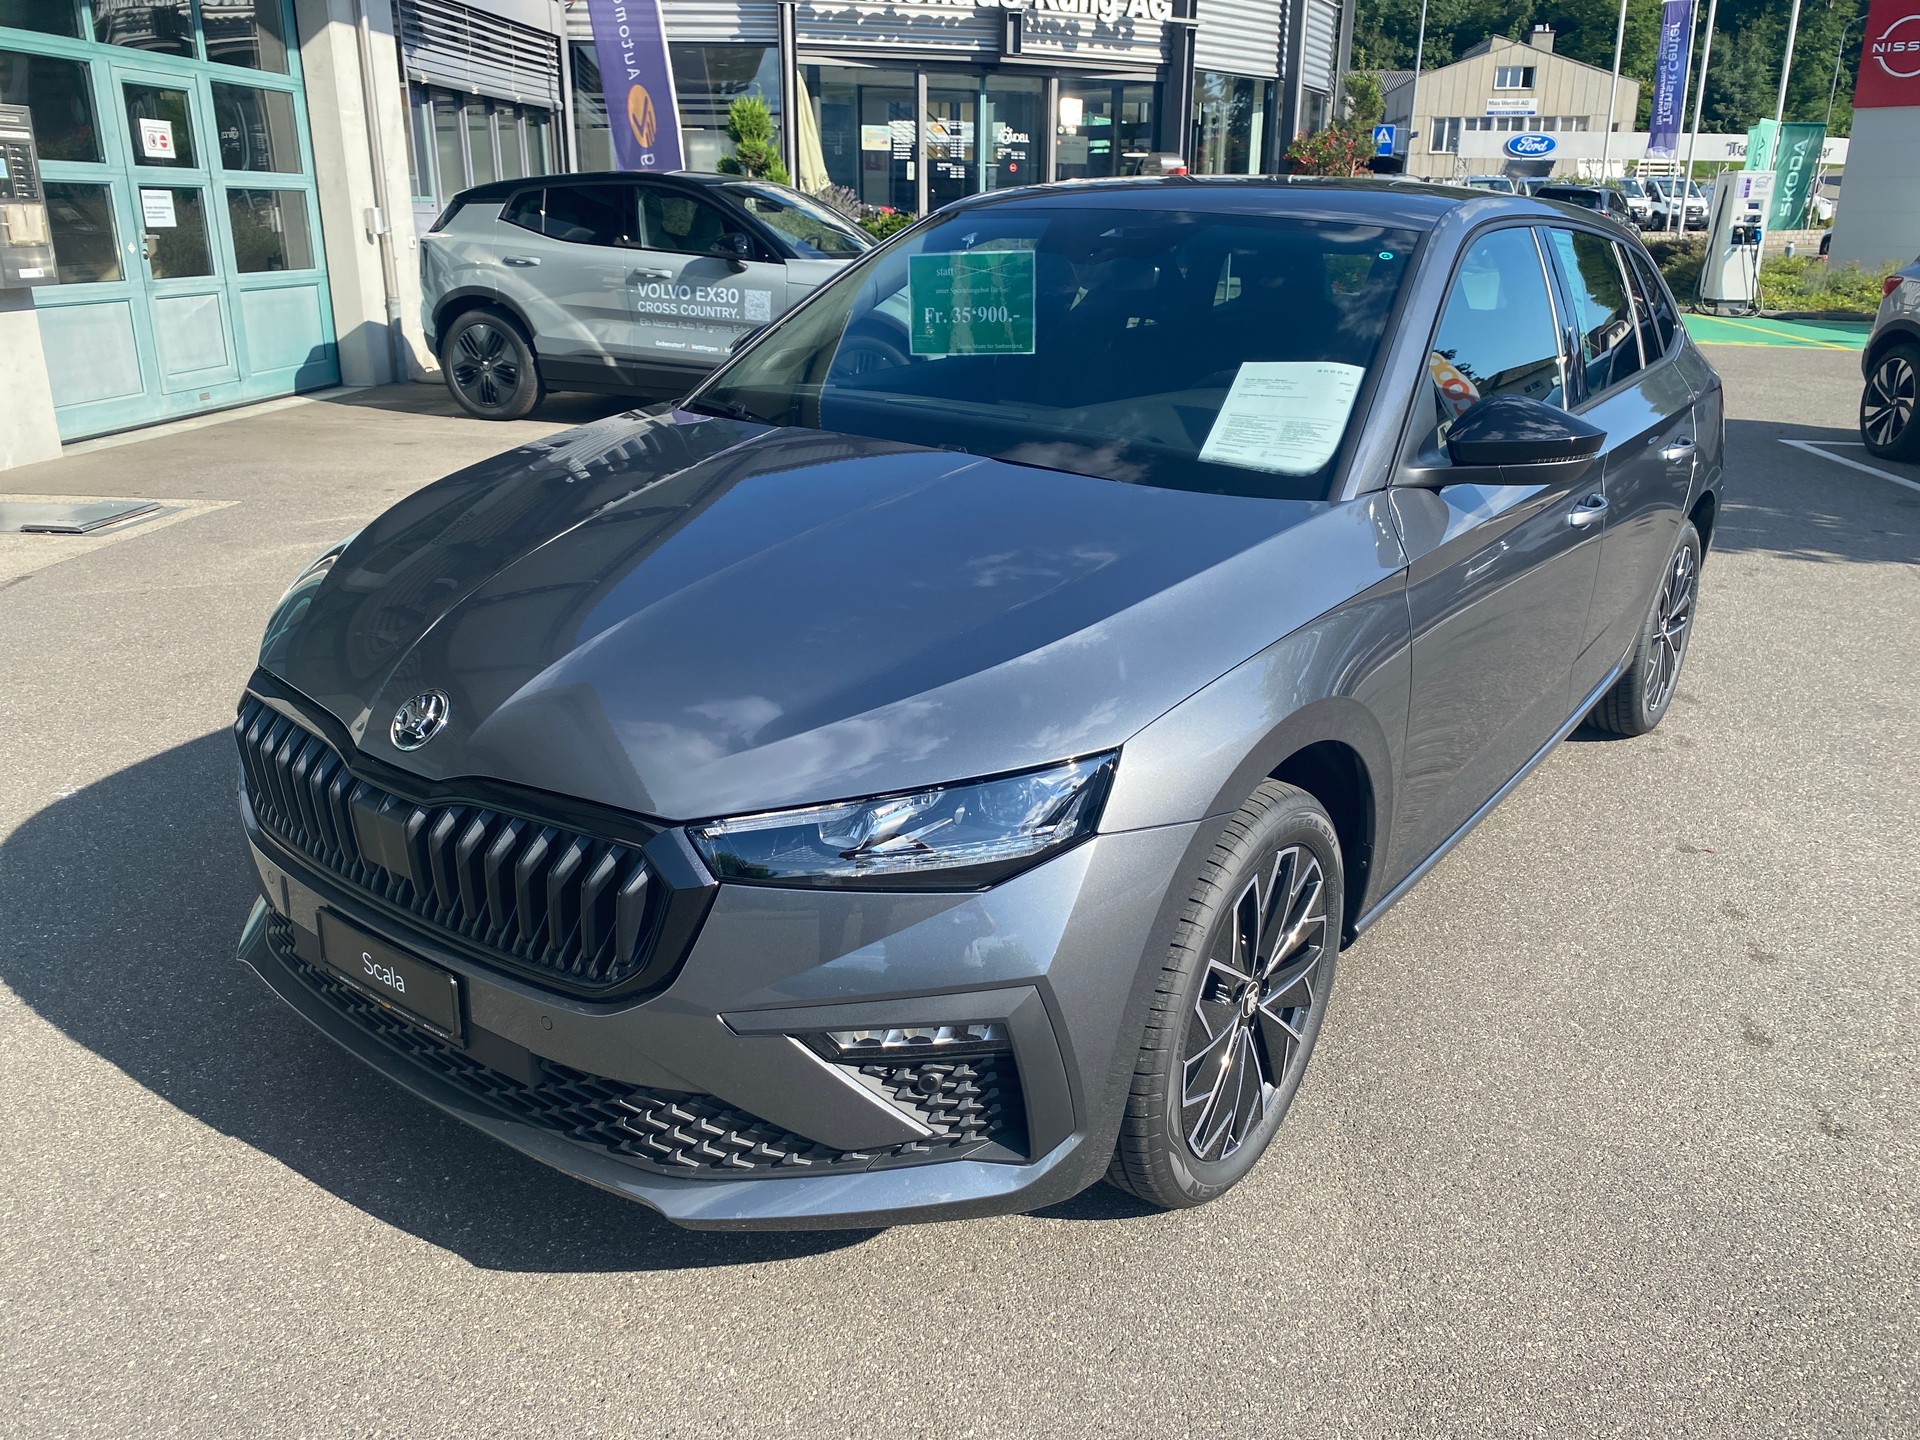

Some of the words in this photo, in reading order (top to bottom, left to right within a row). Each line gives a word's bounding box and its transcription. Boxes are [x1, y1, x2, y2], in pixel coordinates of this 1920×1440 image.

[1126, 0, 1174, 21] AG
[1517, 136, 1549, 152] Ford
[935, 267, 954, 276] statt
[637, 282, 691, 301] VOLVO
[695, 286, 740, 304] EX30
[637, 301, 678, 315] CROSS
[680, 304, 740, 320] COUNTRY.
[924, 307, 947, 324] Fr.
[640, 317, 651, 327] Ein
[653, 318, 677, 329] kleines
[679, 321, 695, 331] Auto
[696, 322, 706, 331] für
[708, 325, 732, 334] grosse
[362, 951, 406, 994] Scala
